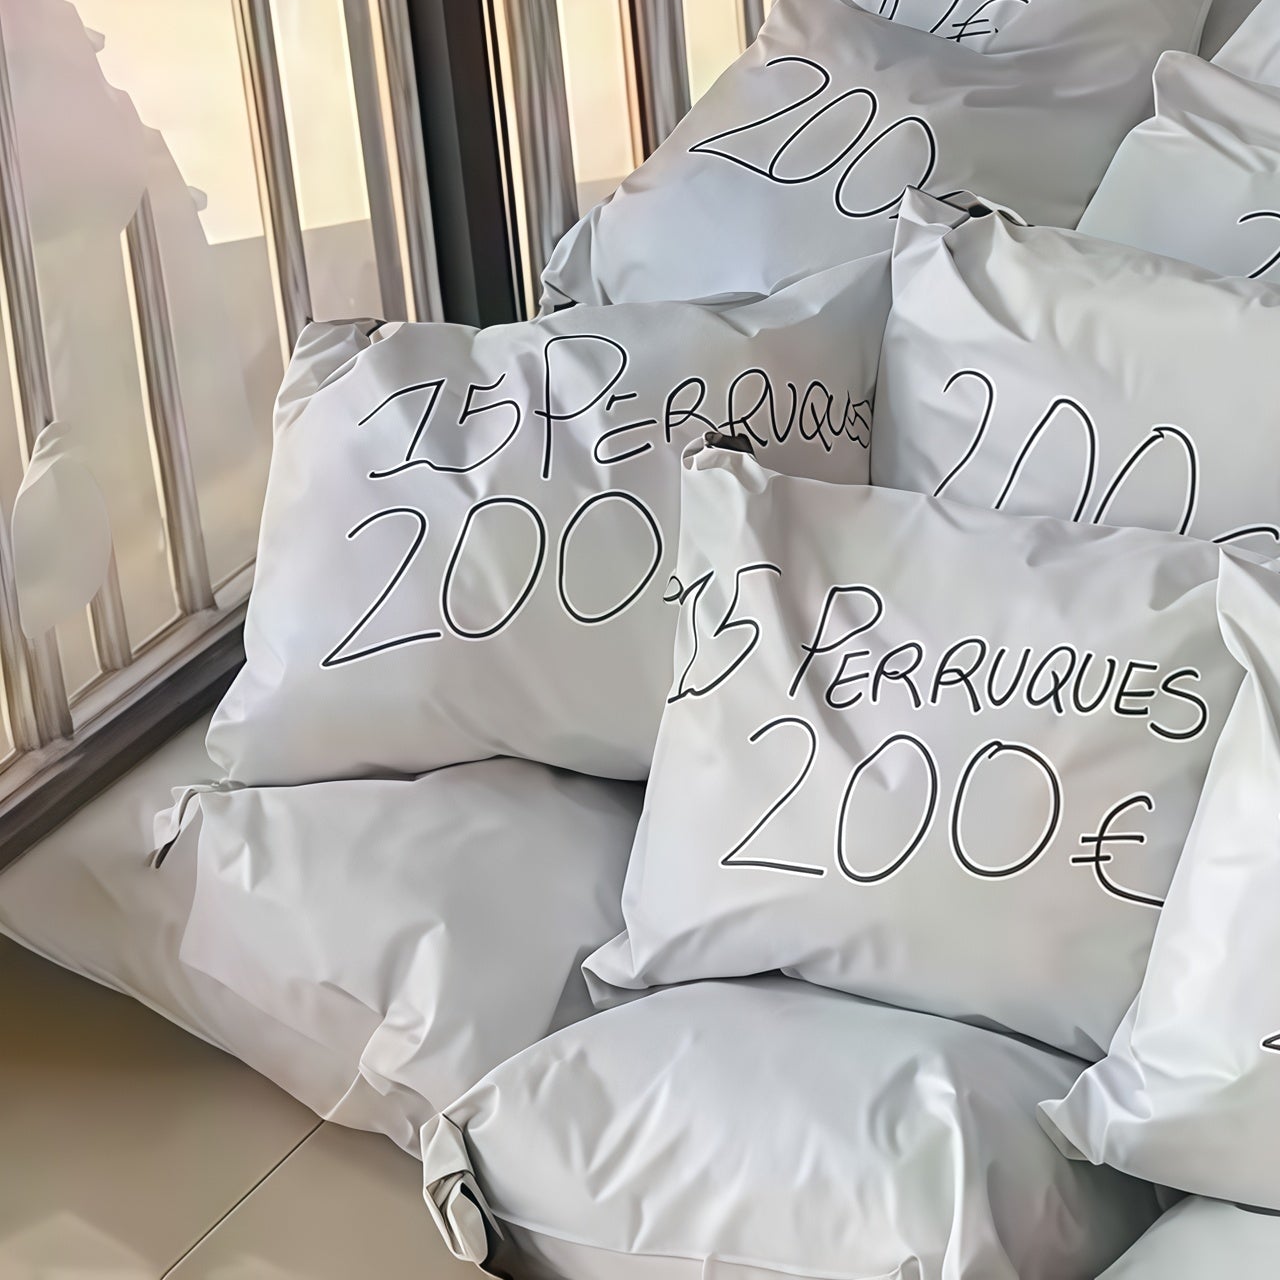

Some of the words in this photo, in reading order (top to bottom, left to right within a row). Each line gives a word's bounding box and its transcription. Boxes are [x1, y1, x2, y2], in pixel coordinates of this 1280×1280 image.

[357, 372, 521, 478] 15
[788, 586, 1208, 739] PERRUQUES
[721, 717, 1164, 908] 200€
